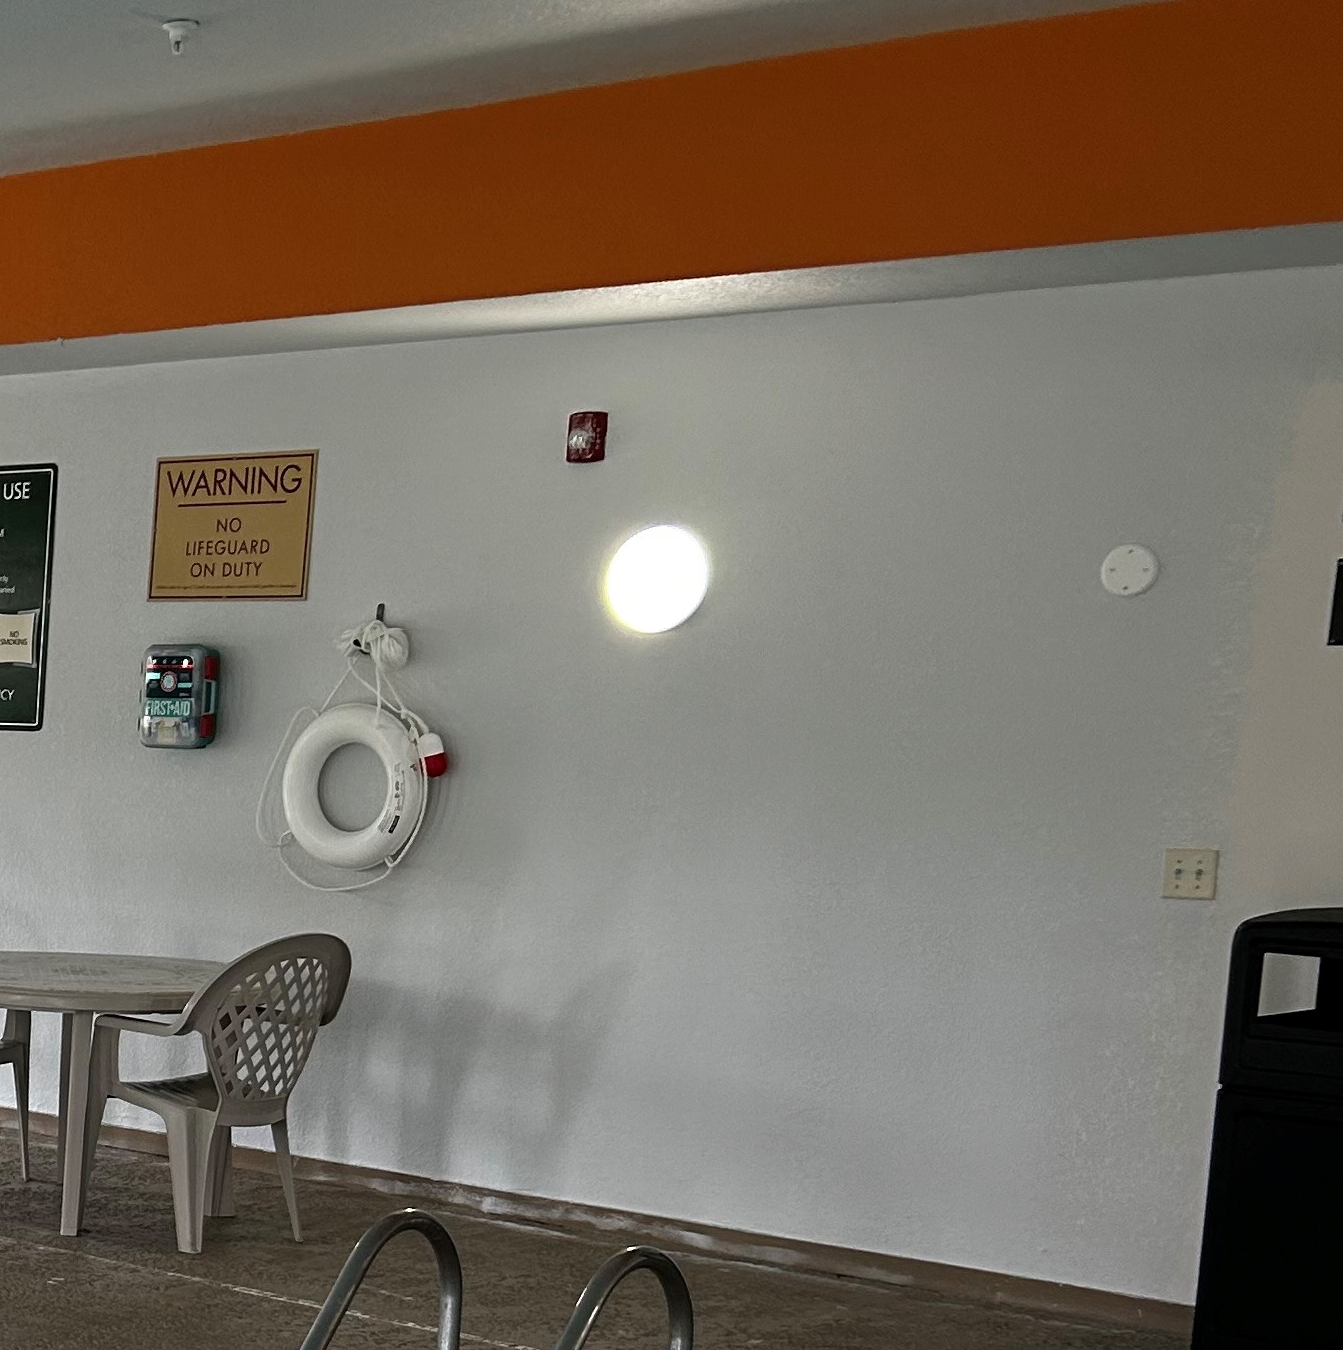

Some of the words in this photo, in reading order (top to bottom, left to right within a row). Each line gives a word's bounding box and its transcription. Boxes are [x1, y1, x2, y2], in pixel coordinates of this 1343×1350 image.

[167, 464, 303, 499] WARNING
[3, 481, 31, 501] USE
[215, 517, 242, 533] NO
[185, 539, 270, 557] LIFEGUARD
[190, 563, 216, 578] ON
[222, 561, 263, 577] DUTY
[145, 700, 172, 716] FIRST
[174, 700, 191, 716] AID
